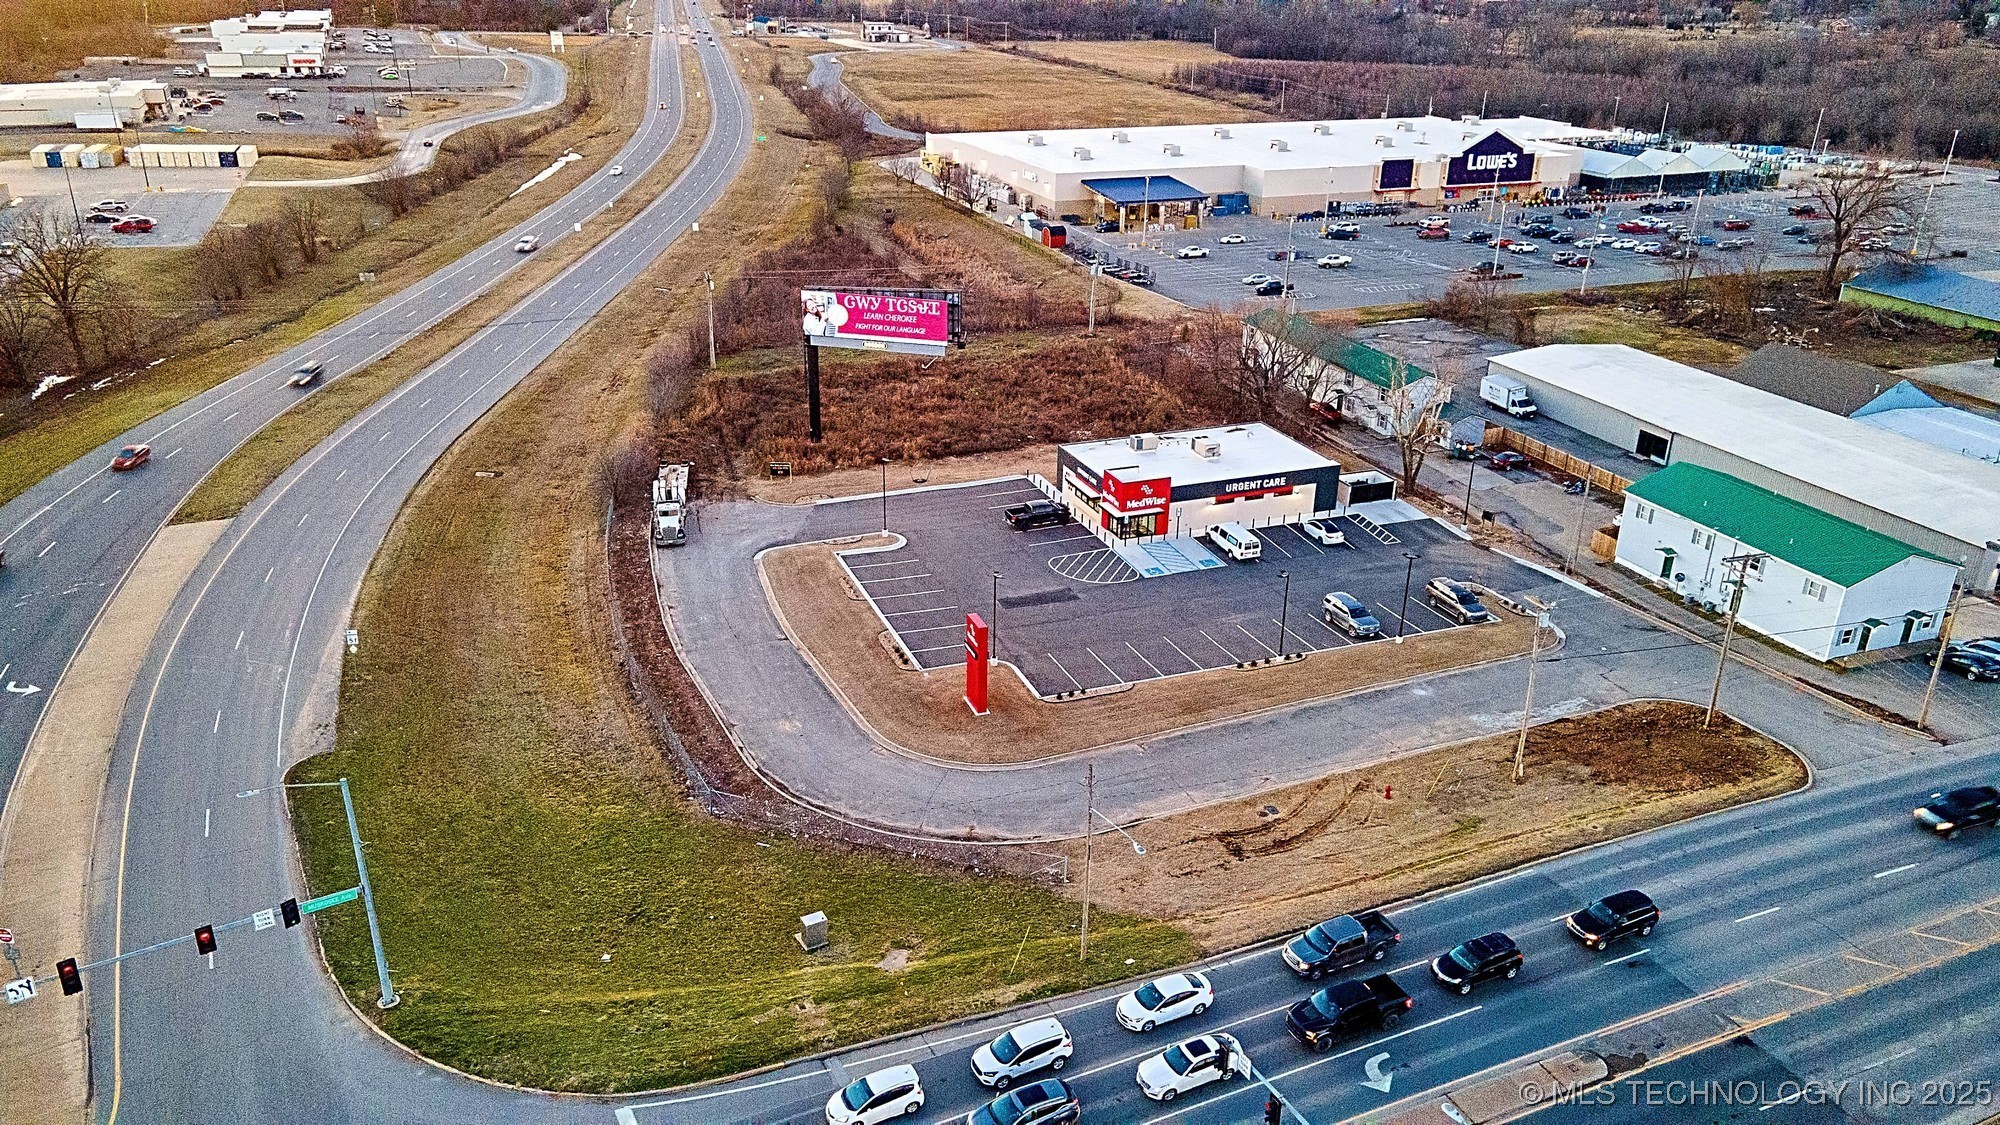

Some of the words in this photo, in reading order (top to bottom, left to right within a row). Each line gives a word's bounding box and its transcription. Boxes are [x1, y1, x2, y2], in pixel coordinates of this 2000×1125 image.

[1467, 152, 1518, 170] LOWE'S
[863, 312, 884, 321] LEARN
[884, 314, 917, 323] CHEROKEE
[896, 326, 926, 335] LANGUAGE
[1225, 480, 1262, 492] URGENT
[1263, 477, 1286, 488] CARE
[1126, 497, 1166, 509] MedWise
